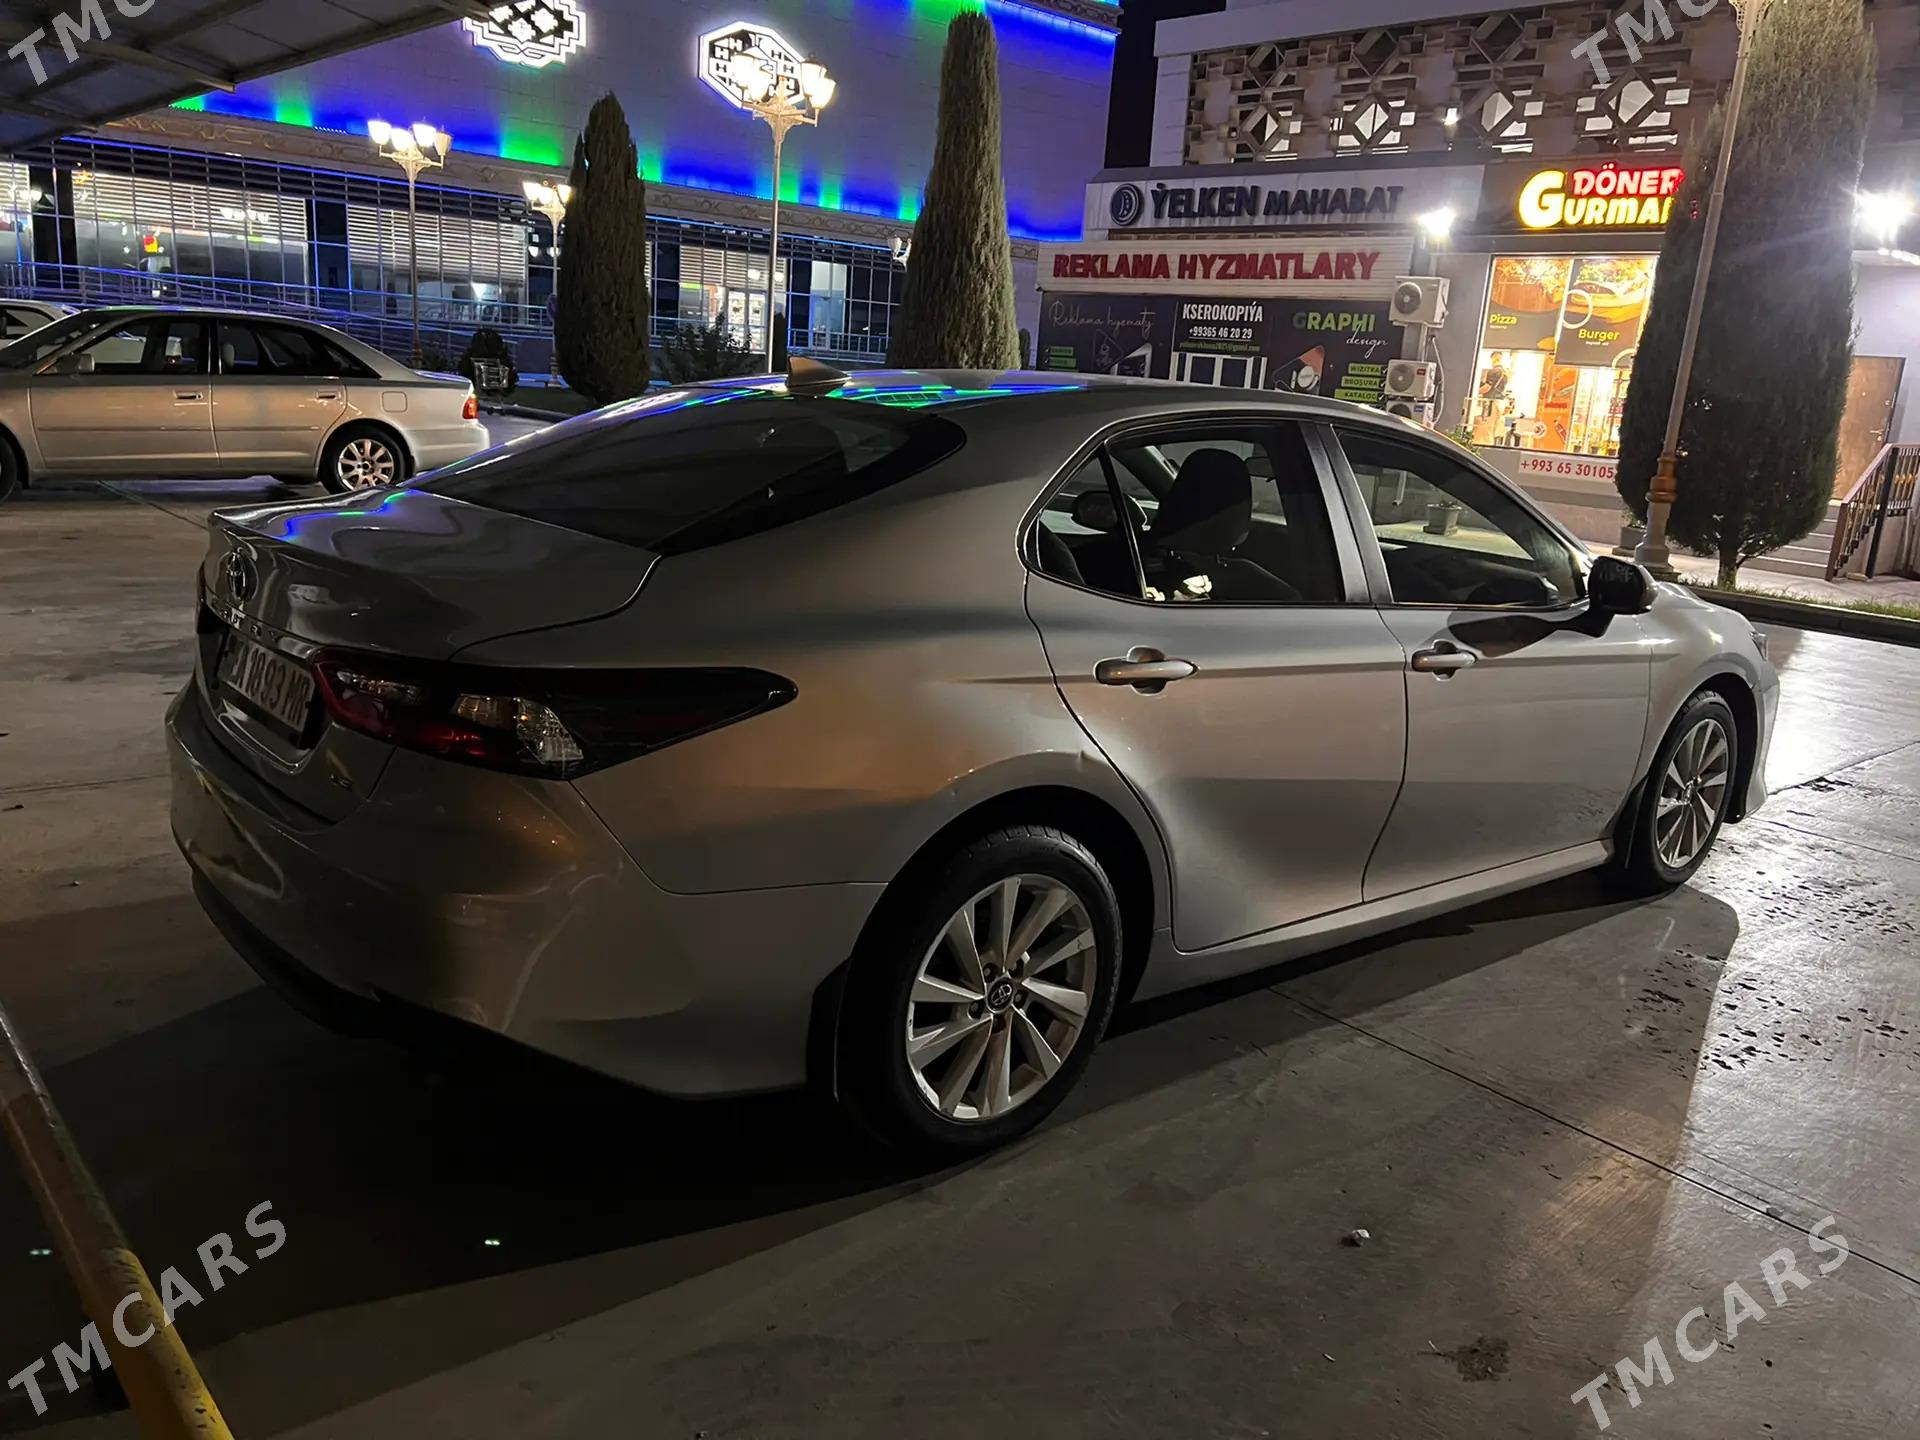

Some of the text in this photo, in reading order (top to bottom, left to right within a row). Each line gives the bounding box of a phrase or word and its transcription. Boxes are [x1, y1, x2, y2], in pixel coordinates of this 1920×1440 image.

[1263, 186, 1404, 216] MAHABAT
[1053, 251, 1381, 281] REKLAMA HYZMATLARY
[1182, 301, 1264, 323] KSEROKOPIÝA
[1189, 326, 1253, 339] +99365 46 20 29
[1578, 328, 1620, 342] Burger
[1557, 462, 1572, 474] 65
